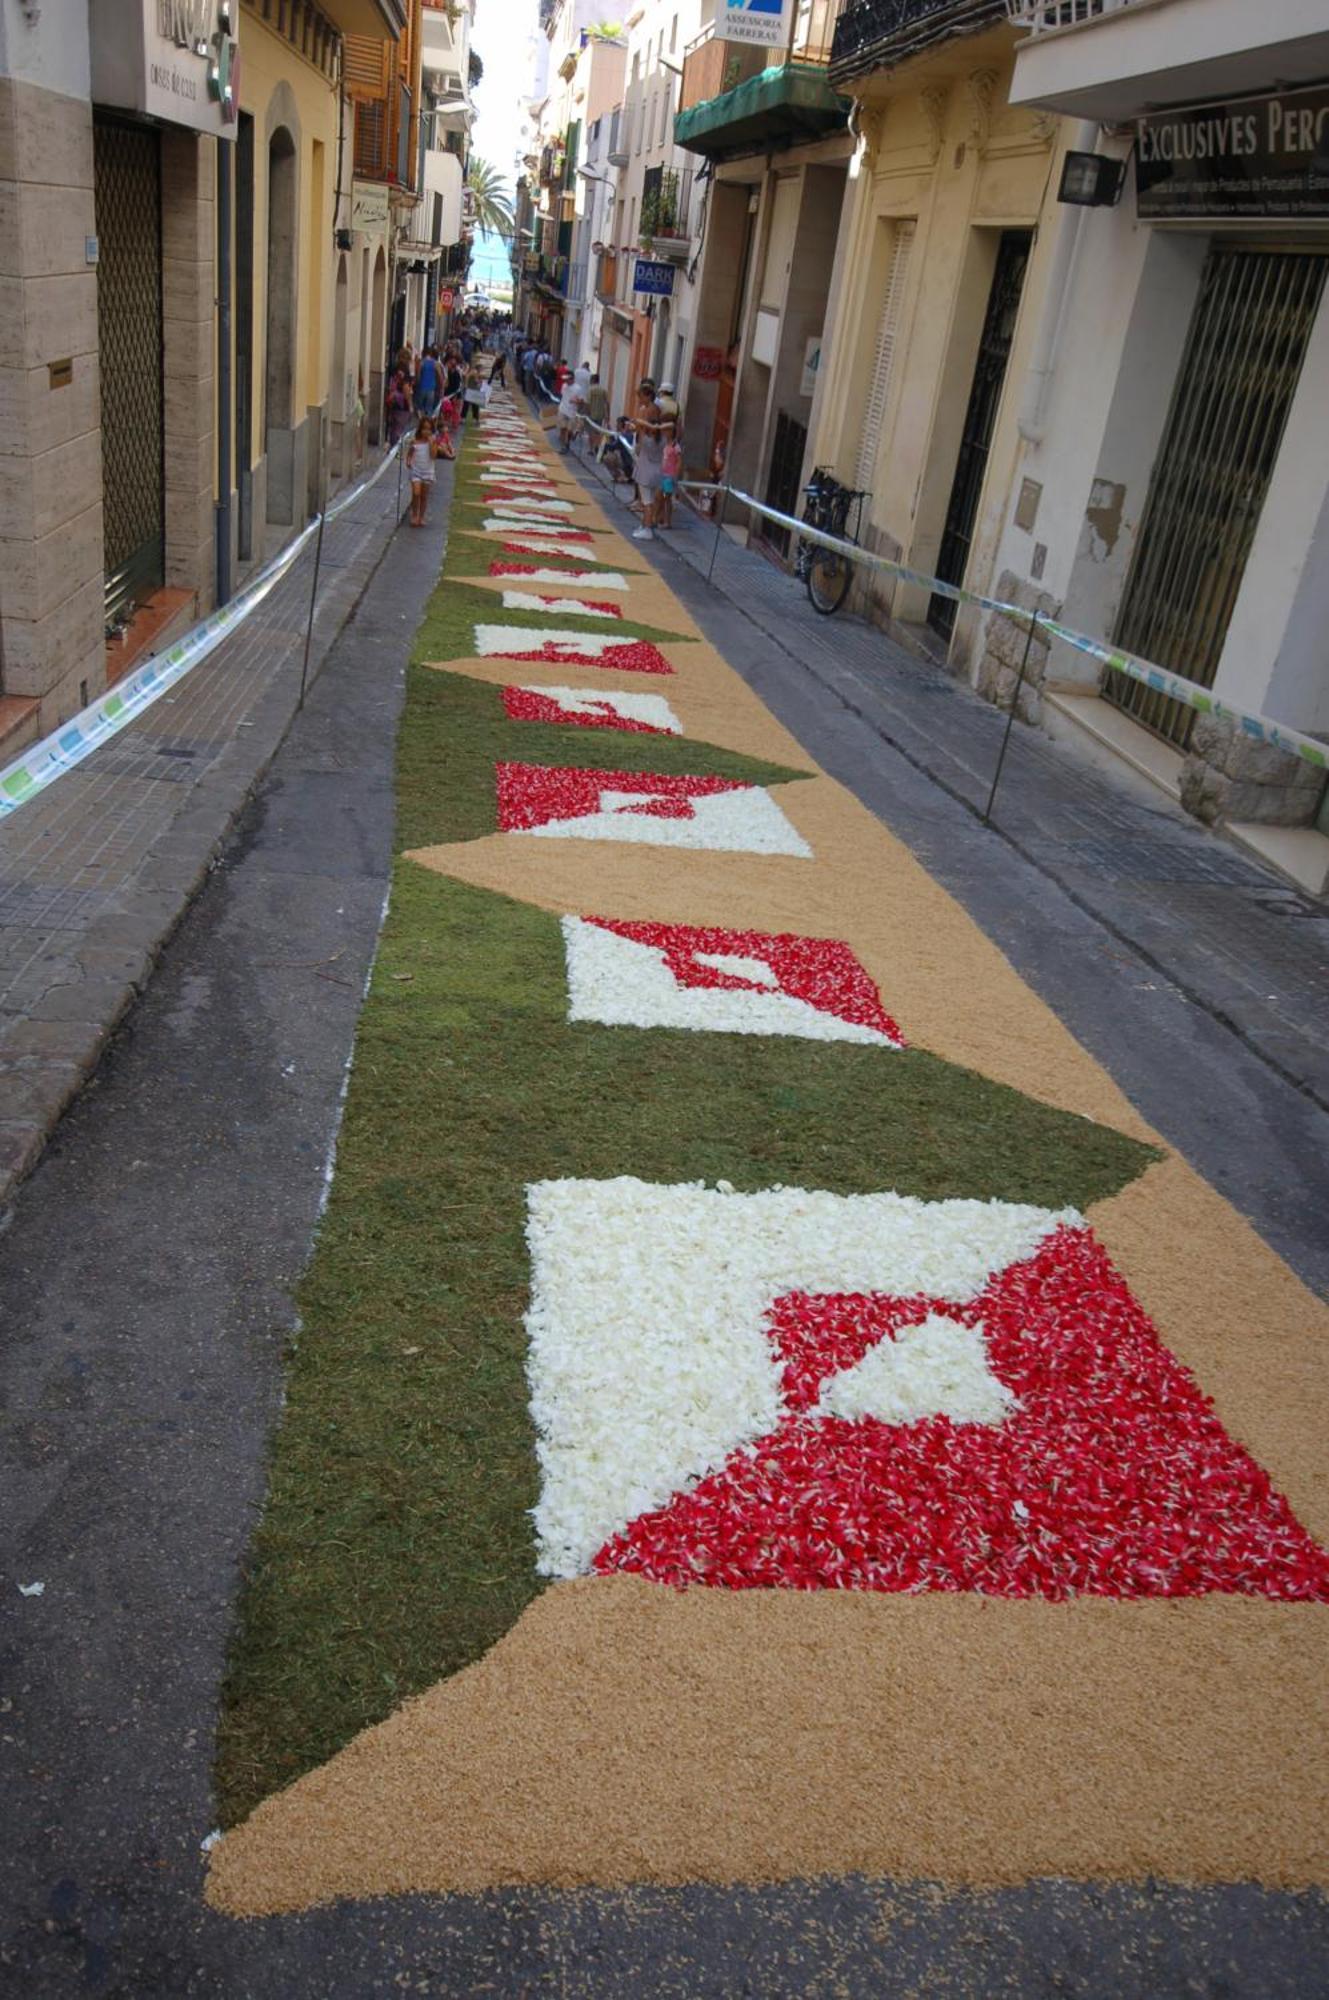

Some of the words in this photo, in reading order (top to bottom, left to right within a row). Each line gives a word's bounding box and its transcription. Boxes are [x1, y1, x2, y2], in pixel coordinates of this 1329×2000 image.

[725, 13, 782, 29] ASSESSORIA
[726, 25, 778, 40] FARRERAS
[1137, 114, 1258, 163] EXCLUSIVES
[636, 264, 673, 283] DARK
